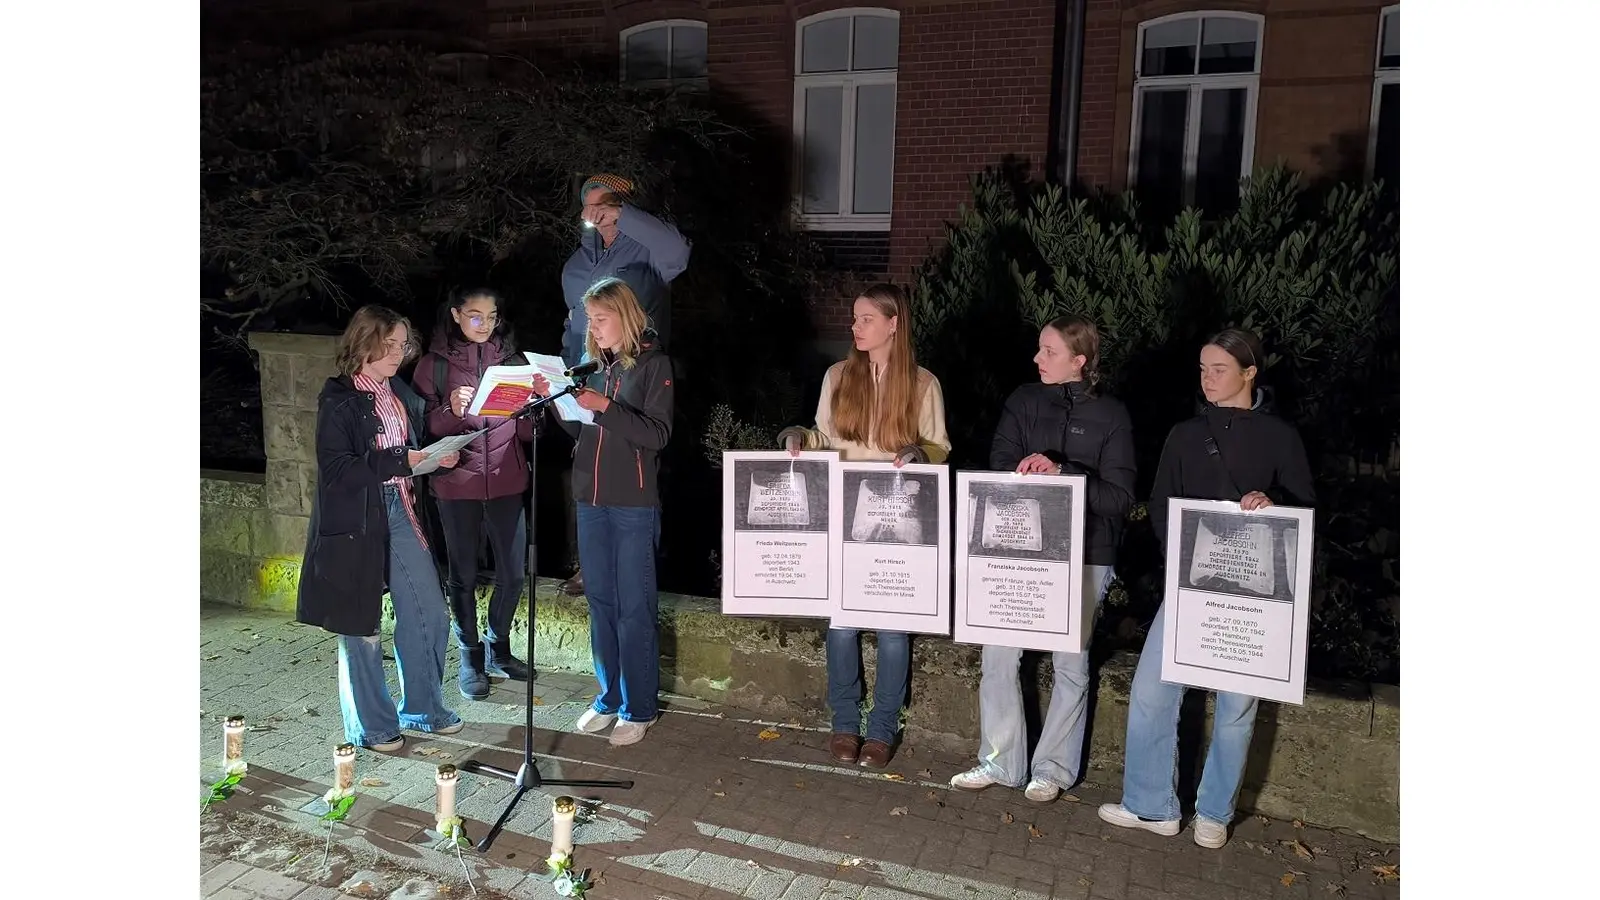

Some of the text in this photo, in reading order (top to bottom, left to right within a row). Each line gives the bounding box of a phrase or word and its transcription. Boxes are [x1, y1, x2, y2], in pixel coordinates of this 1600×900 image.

[1213, 538, 1257, 550] JACOBSOHN
[1209, 551, 1242, 560] DEPORTIERT
[1197, 562, 1226, 571] ERMORDET
[1210, 557, 1257, 569] THERESIENSTADT
[1214, 571, 1250, 581] AUSCHWITZ
[1008, 598, 1034, 606] Hamburg
[1205, 600, 1263, 614] Alfred Jacobsohn
[1004, 604, 1044, 612] Theresienstadt
[1223, 617, 1258, 628] 27.09.1870
[1200, 621, 1266, 636] deportiert 15.07.1942
[1222, 632, 1251, 642] Hamburg
[1219, 638, 1263, 650] Theresienstadt
[1200, 644, 1264, 657] ermordet 15.05.1944
[1220, 653, 1250, 663] Auschwitz
